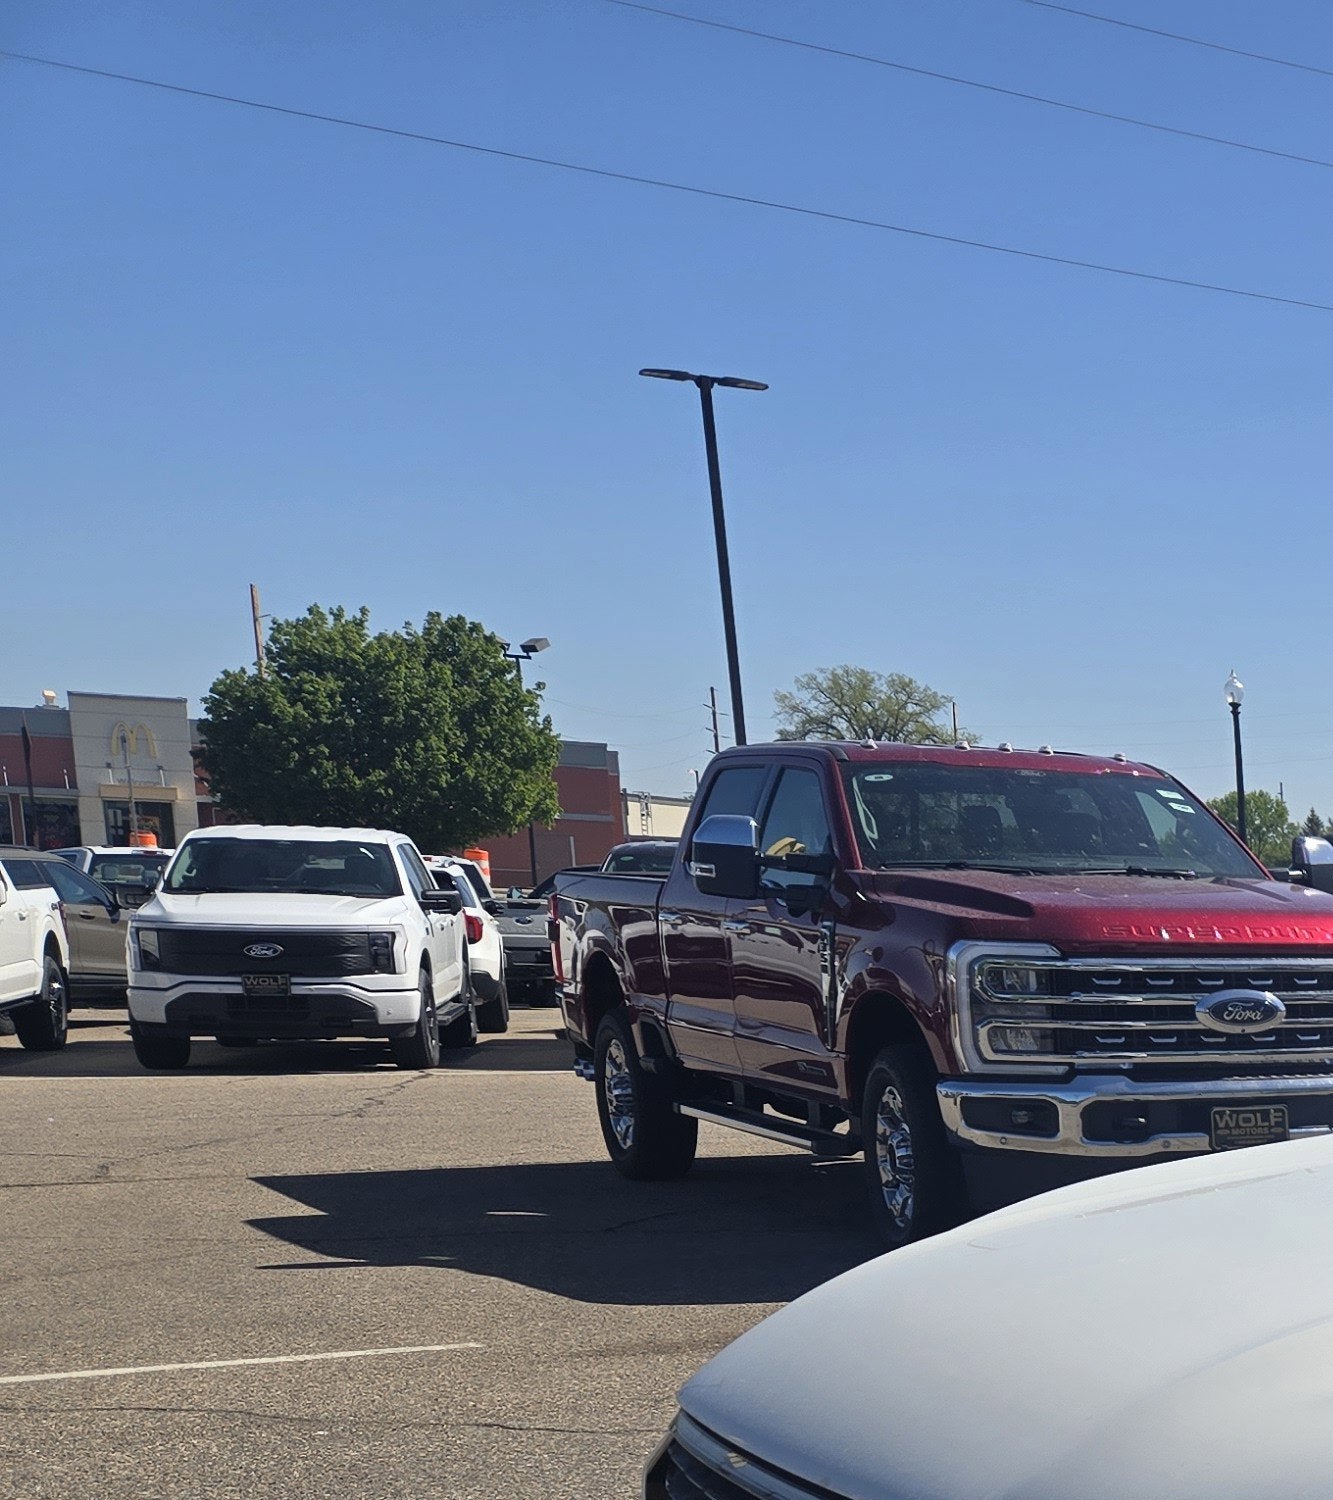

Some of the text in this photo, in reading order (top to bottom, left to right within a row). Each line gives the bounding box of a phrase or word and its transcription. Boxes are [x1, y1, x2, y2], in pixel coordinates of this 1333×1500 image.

[1102, 925, 1243, 940] SUPER
[245, 977, 287, 985] WOLF
[1223, 1002, 1264, 1021] Ford
[1215, 1112, 1283, 1128] WOLF
[1230, 1127, 1269, 1135] MOTORS
